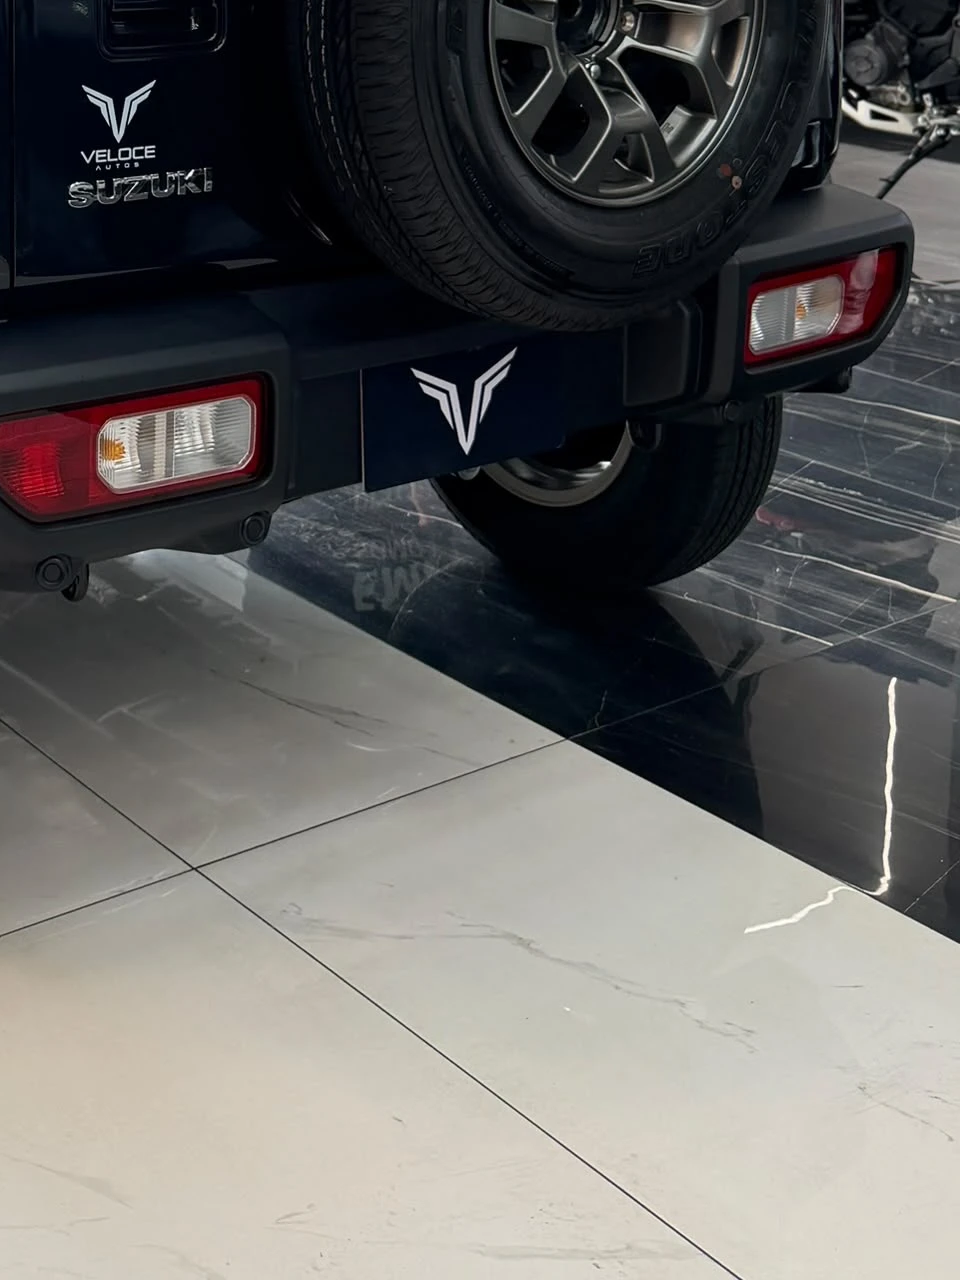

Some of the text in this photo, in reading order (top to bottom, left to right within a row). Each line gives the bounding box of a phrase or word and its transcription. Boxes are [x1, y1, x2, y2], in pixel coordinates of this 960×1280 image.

[80, 145, 156, 164] VELOCE
[96, 162, 140, 170] AUTOS
[68, 167, 213, 208] SUZUKI
